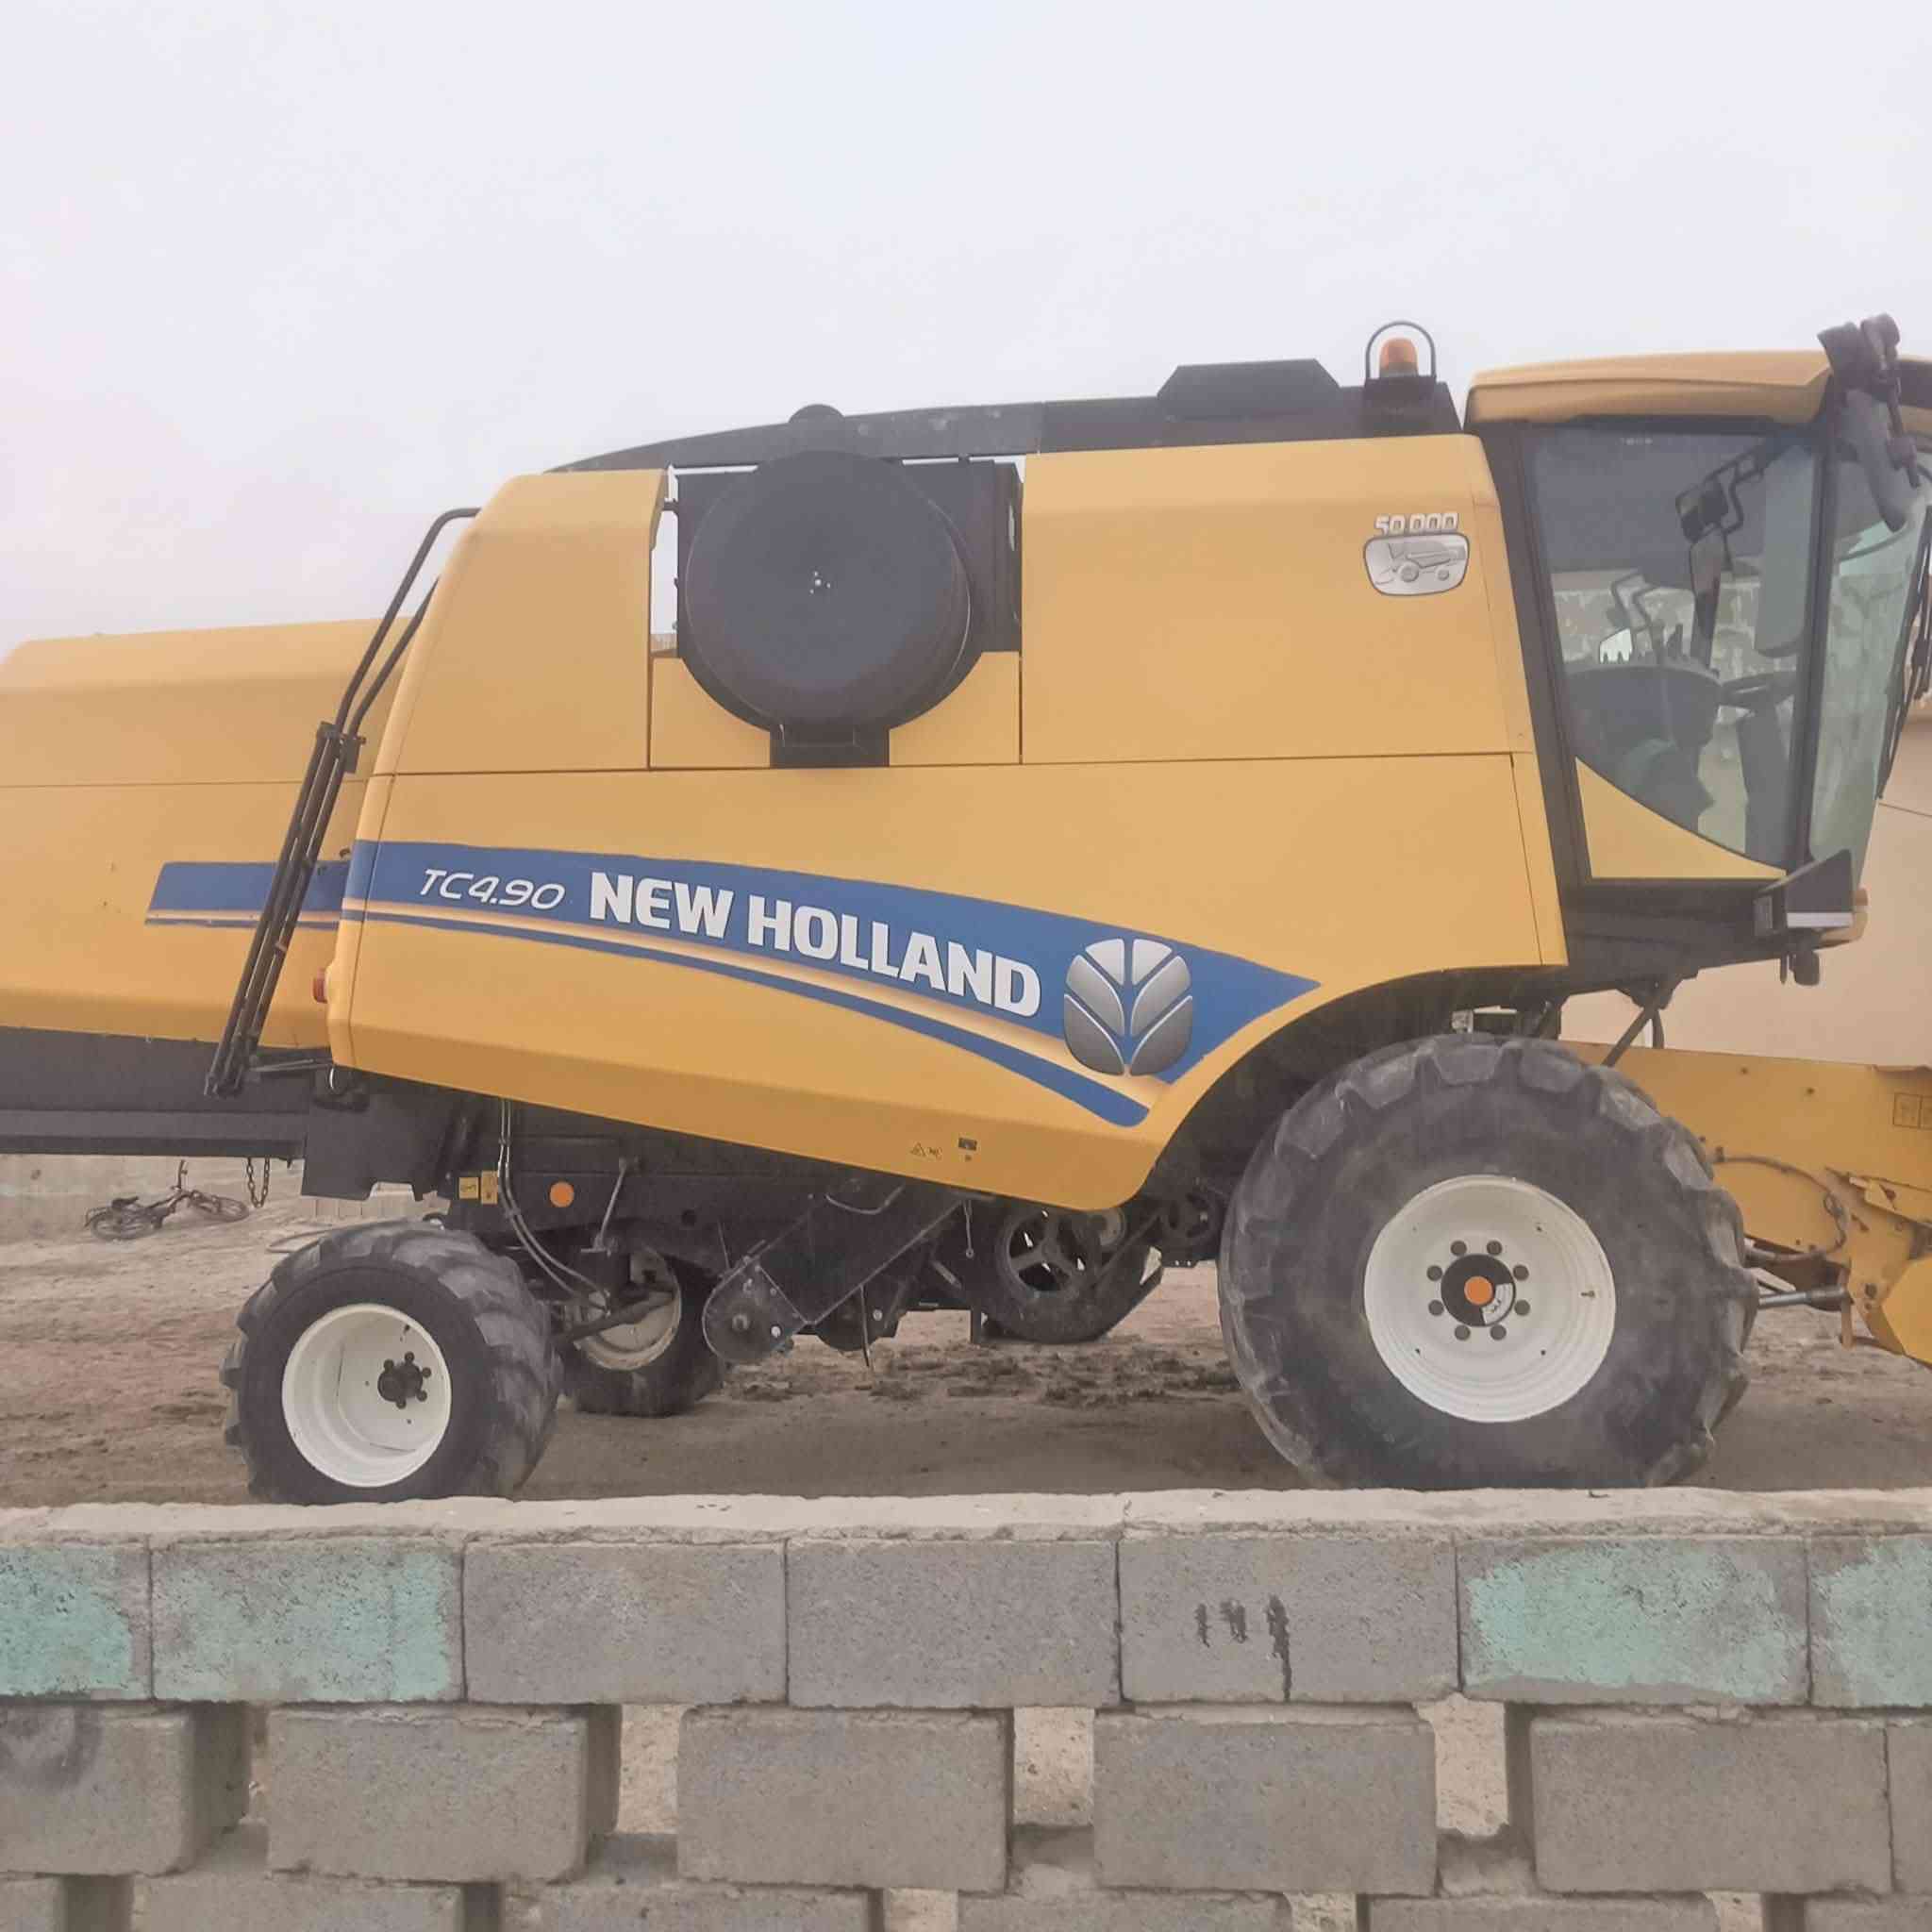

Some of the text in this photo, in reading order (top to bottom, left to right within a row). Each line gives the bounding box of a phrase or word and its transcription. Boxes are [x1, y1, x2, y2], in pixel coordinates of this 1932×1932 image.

[420, 869, 565, 910] TC4.90
[589, 871, 1042, 1018] NEW HOLLAND
